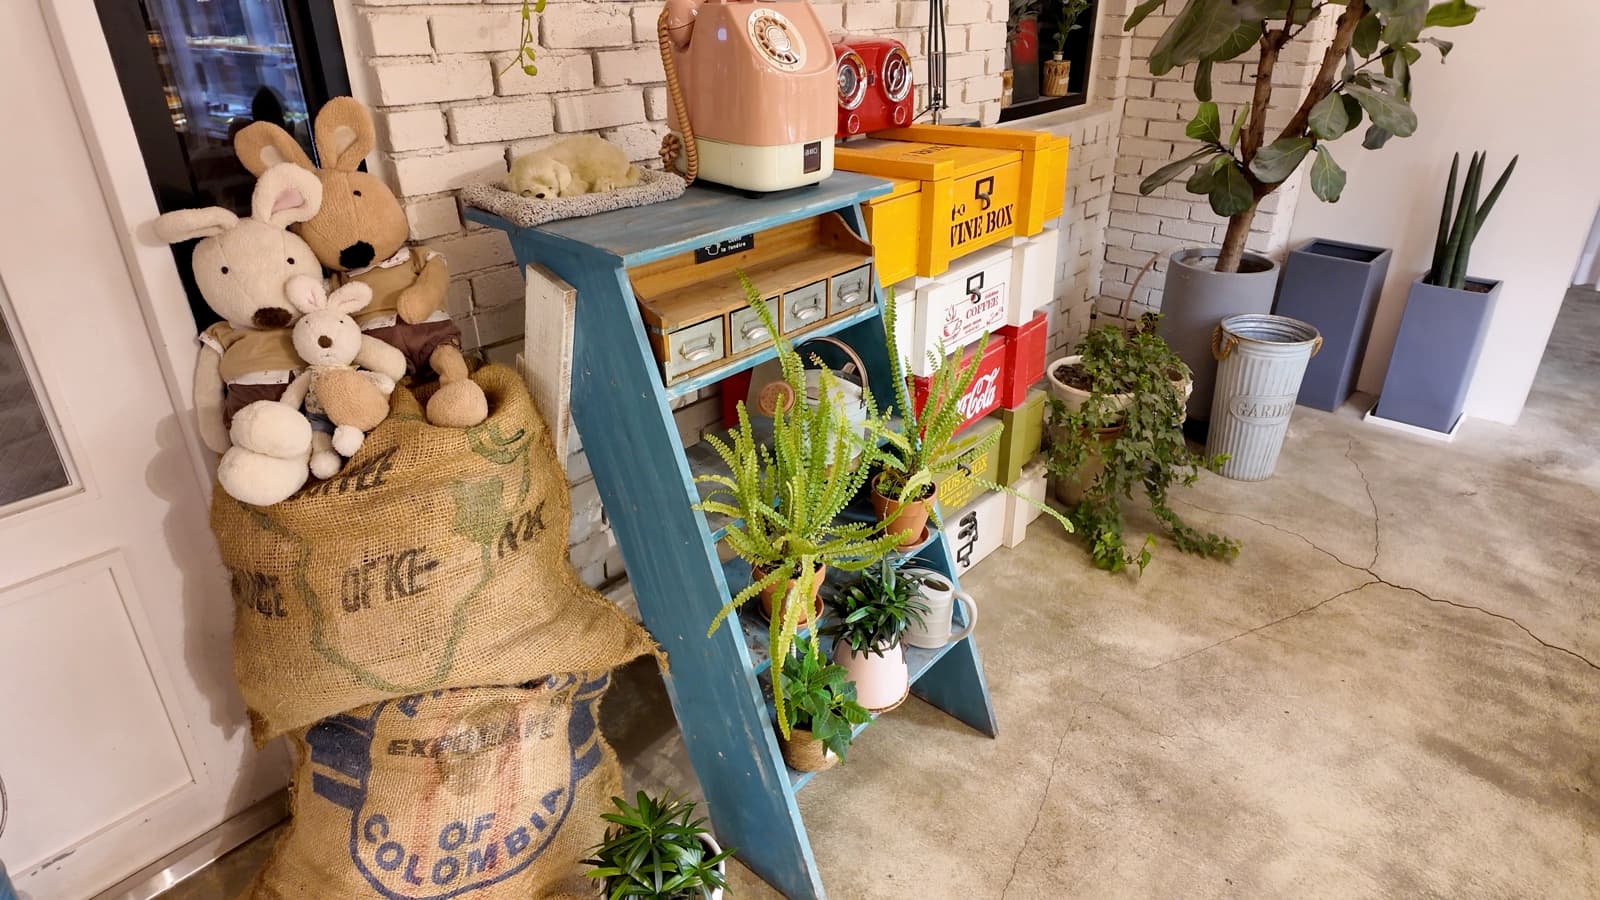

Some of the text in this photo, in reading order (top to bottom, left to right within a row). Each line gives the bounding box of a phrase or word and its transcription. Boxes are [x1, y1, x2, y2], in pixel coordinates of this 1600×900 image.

[985, 203, 1014, 234] BOX
[966, 295, 999, 320] COFFEE
[364, 787, 564, 887] COLOMBIA
[438, 812, 496, 851] OF
